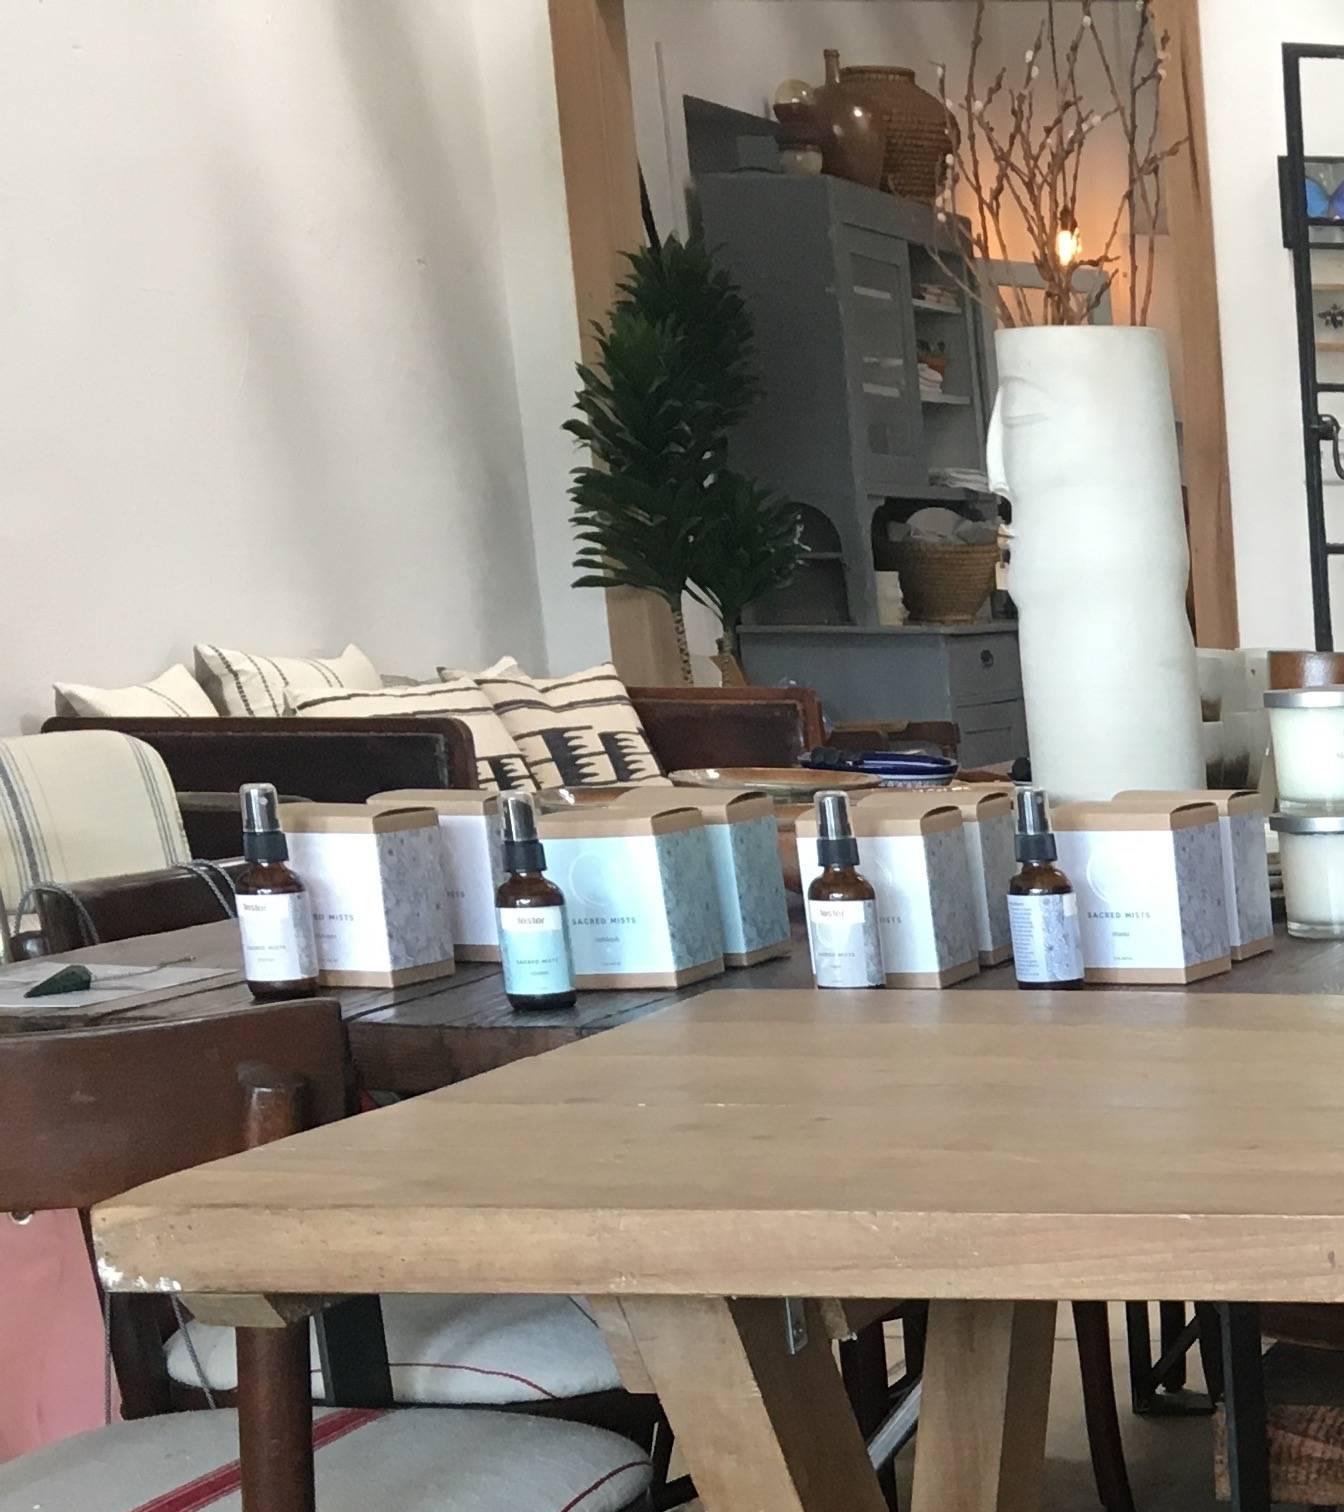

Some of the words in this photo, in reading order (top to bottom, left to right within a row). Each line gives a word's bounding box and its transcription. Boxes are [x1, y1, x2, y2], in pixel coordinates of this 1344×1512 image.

[328, 913, 355, 922] MISTS
[1087, 911, 1121, 919] SACRED
[1125, 911, 1152, 919] MISTS
[571, 917, 606, 926] SACRED
[609, 916, 637, 925] MISTS
